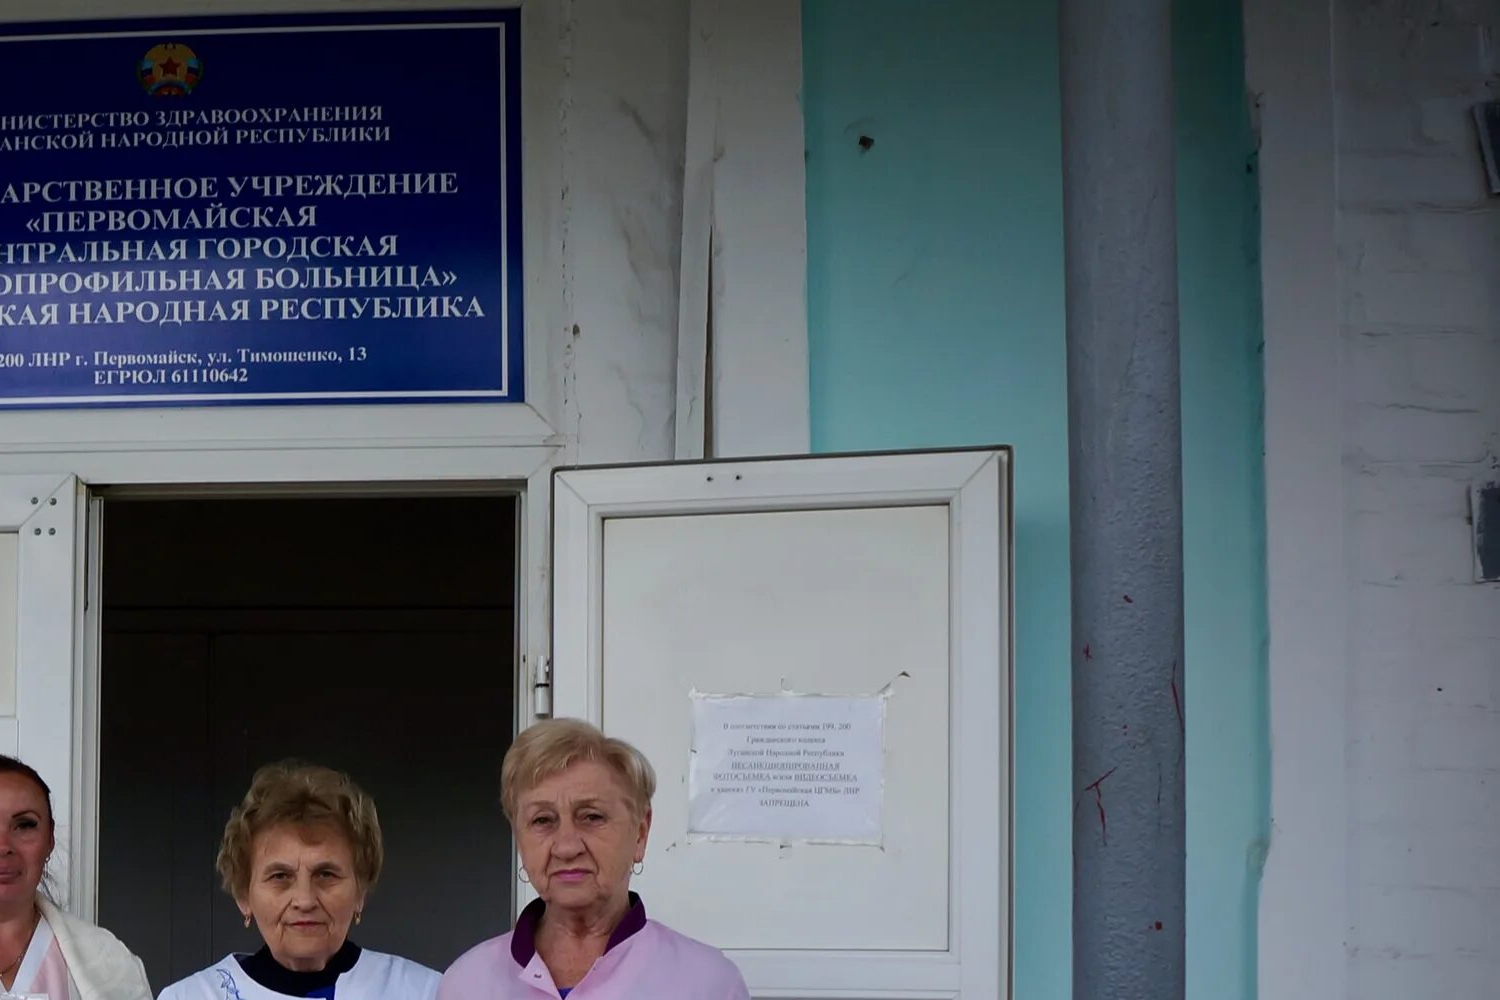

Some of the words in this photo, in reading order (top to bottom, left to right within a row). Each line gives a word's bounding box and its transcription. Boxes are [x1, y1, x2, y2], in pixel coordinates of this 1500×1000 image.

[155, 105, 383, 127] ЗДРАВООХРАНЕНИЯ
[100, 127, 229, 149] НАРОДНОЙ
[236, 125, 391, 145] РЕСПУБЛИКИ
[227, 172, 459, 200] УЧРЕЖДЕНИЕ
[26, 202, 317, 233] «ПЕРВОМАЙСКАЯ
[197, 235, 399, 262] ГОРОДСКАЯ
[255, 265, 458, 291] БОЛЬНИЦА»
[69, 299, 250, 327] НАРОДНАЯ
[260, 296, 485, 320] РЕСПУБЛИКА
[28, 352, 71, 368] ЛНР
[75, 356, 88, 367] г.
[94, 350, 202, 367] Первомайск,
[207, 351, 232, 368] ул.
[237, 347, 343, 365] Тимошенко,
[348, 347, 367, 362] 13
[94, 369, 166, 385] ЕГРЮЛ
[171, 368, 248, 384] 61110642
